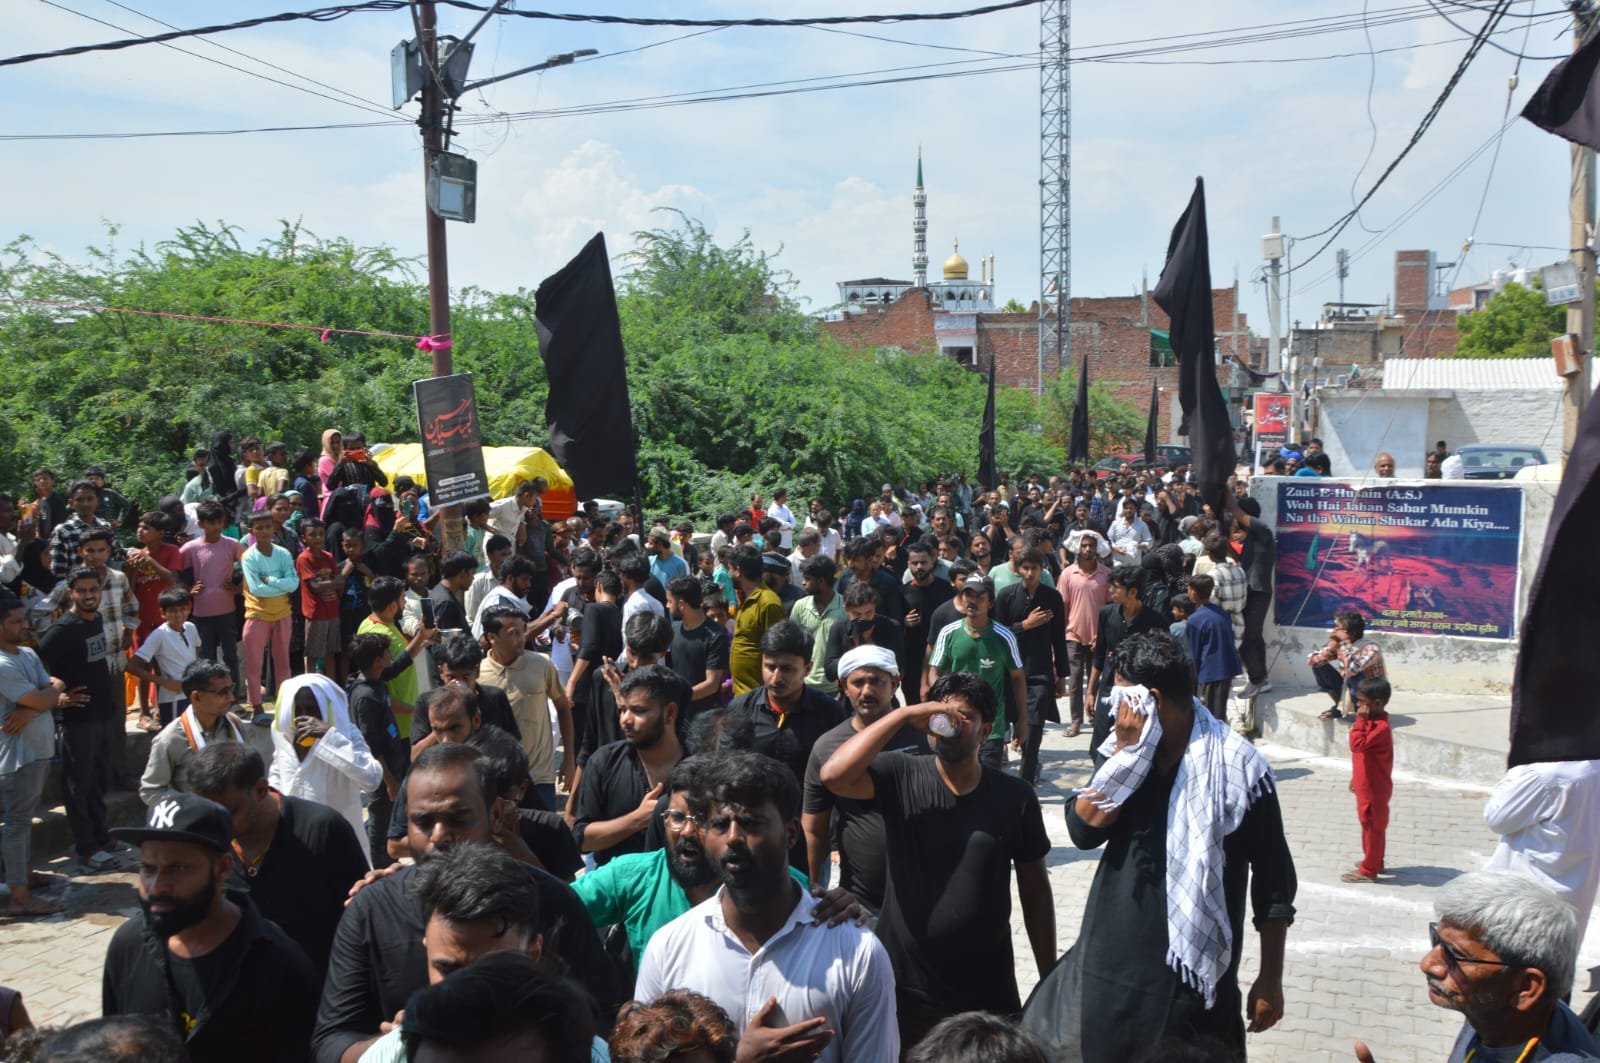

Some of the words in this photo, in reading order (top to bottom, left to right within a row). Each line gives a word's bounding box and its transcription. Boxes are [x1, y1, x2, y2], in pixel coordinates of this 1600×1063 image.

[1386, 489, 1424, 500] (A.S.)
[1286, 499, 1313, 510] Woh
[1317, 500, 1340, 511] Hai
[1343, 501, 1384, 512] Jahan
[1387, 502, 1428, 514] Sabar
[1430, 503, 1489, 515] Mumkin
[1286, 513, 1304, 523] Na
[1308, 513, 1328, 523] tha
[1332, 514, 1376, 525] Wahan
[1379, 515, 1430, 527] Shukar
[1431, 517, 1459, 528] Ada
[149, 799, 181, 829] NY
